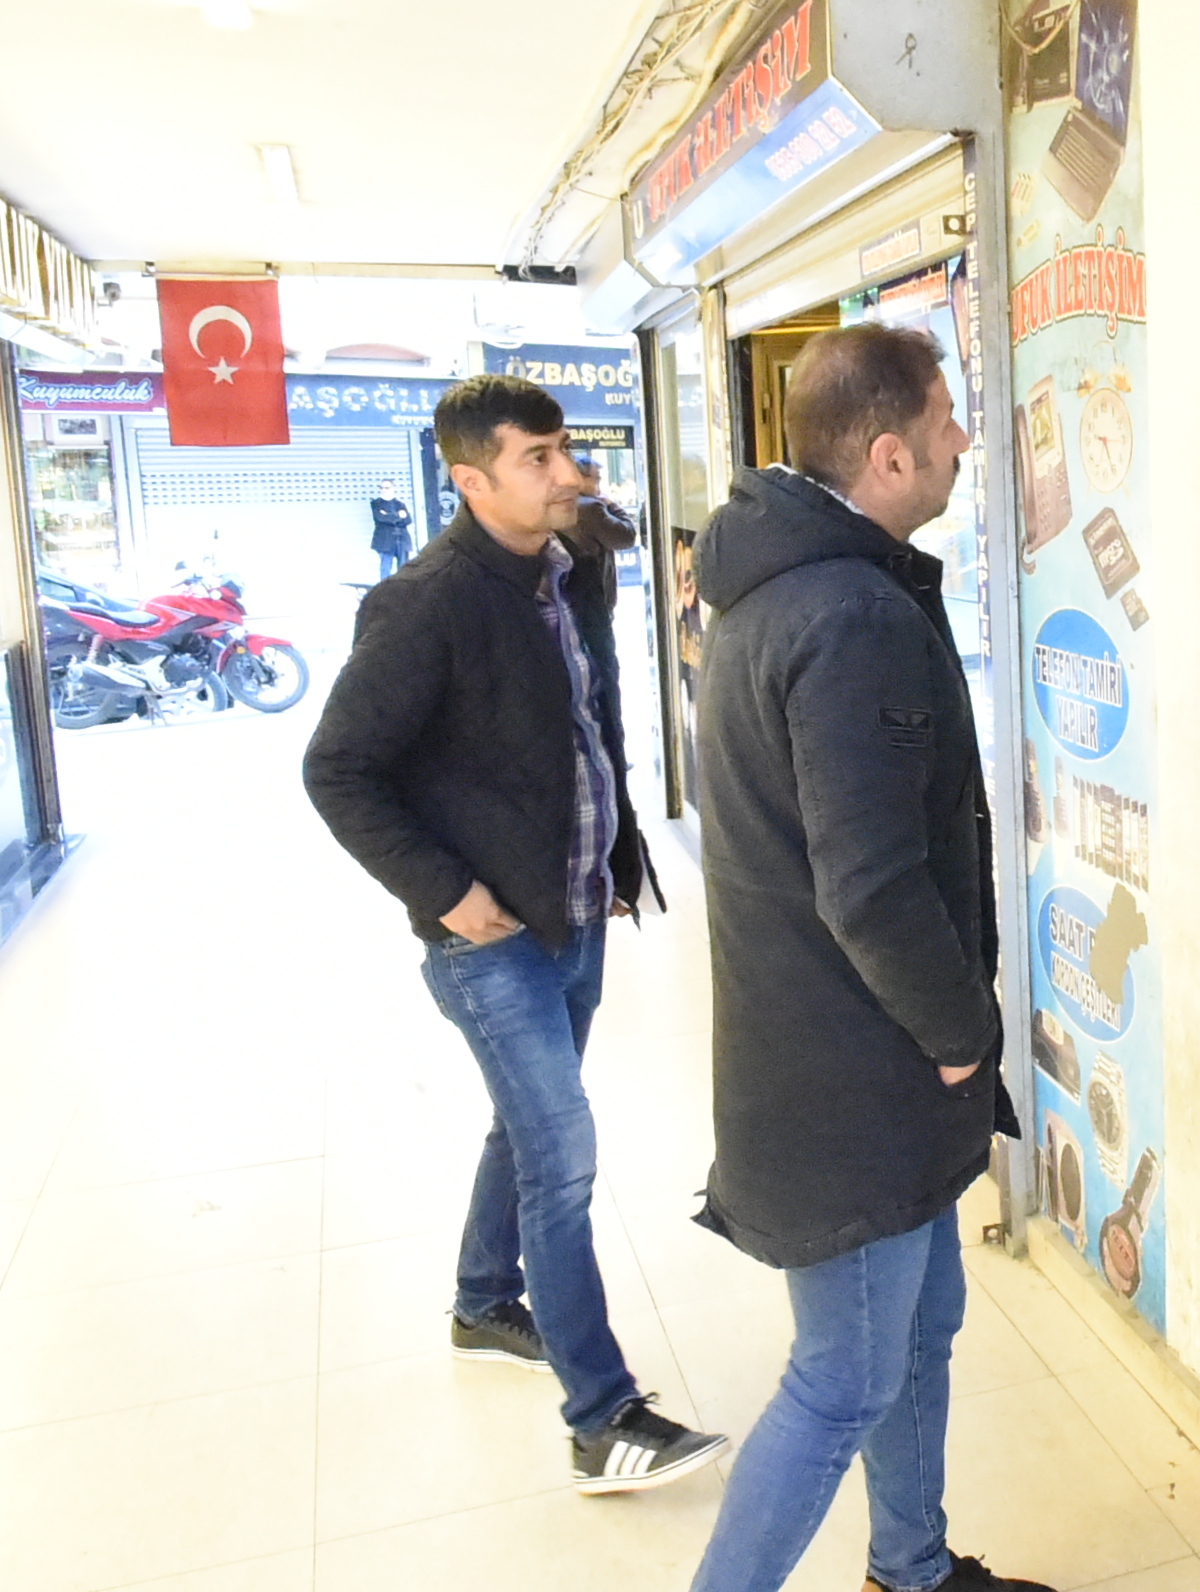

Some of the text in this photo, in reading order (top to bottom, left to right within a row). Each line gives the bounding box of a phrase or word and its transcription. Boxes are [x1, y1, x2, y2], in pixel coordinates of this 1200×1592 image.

[964, 172, 977, 232] CEP
[1054, 223, 1147, 339] İLETİŞİM
[966, 240, 983, 392] TELEFONU
[504, 355, 633, 392] ÖZBAŞOĞ
[568, 426, 626, 443] BAŞOĞLU
[976, 534, 991, 657] YAPILIR
[1035, 643, 1123, 708] TELEFON TAMİRİ
[1055, 694, 1099, 753] YAPILIR
[1049, 903, 1085, 962] SAAT
